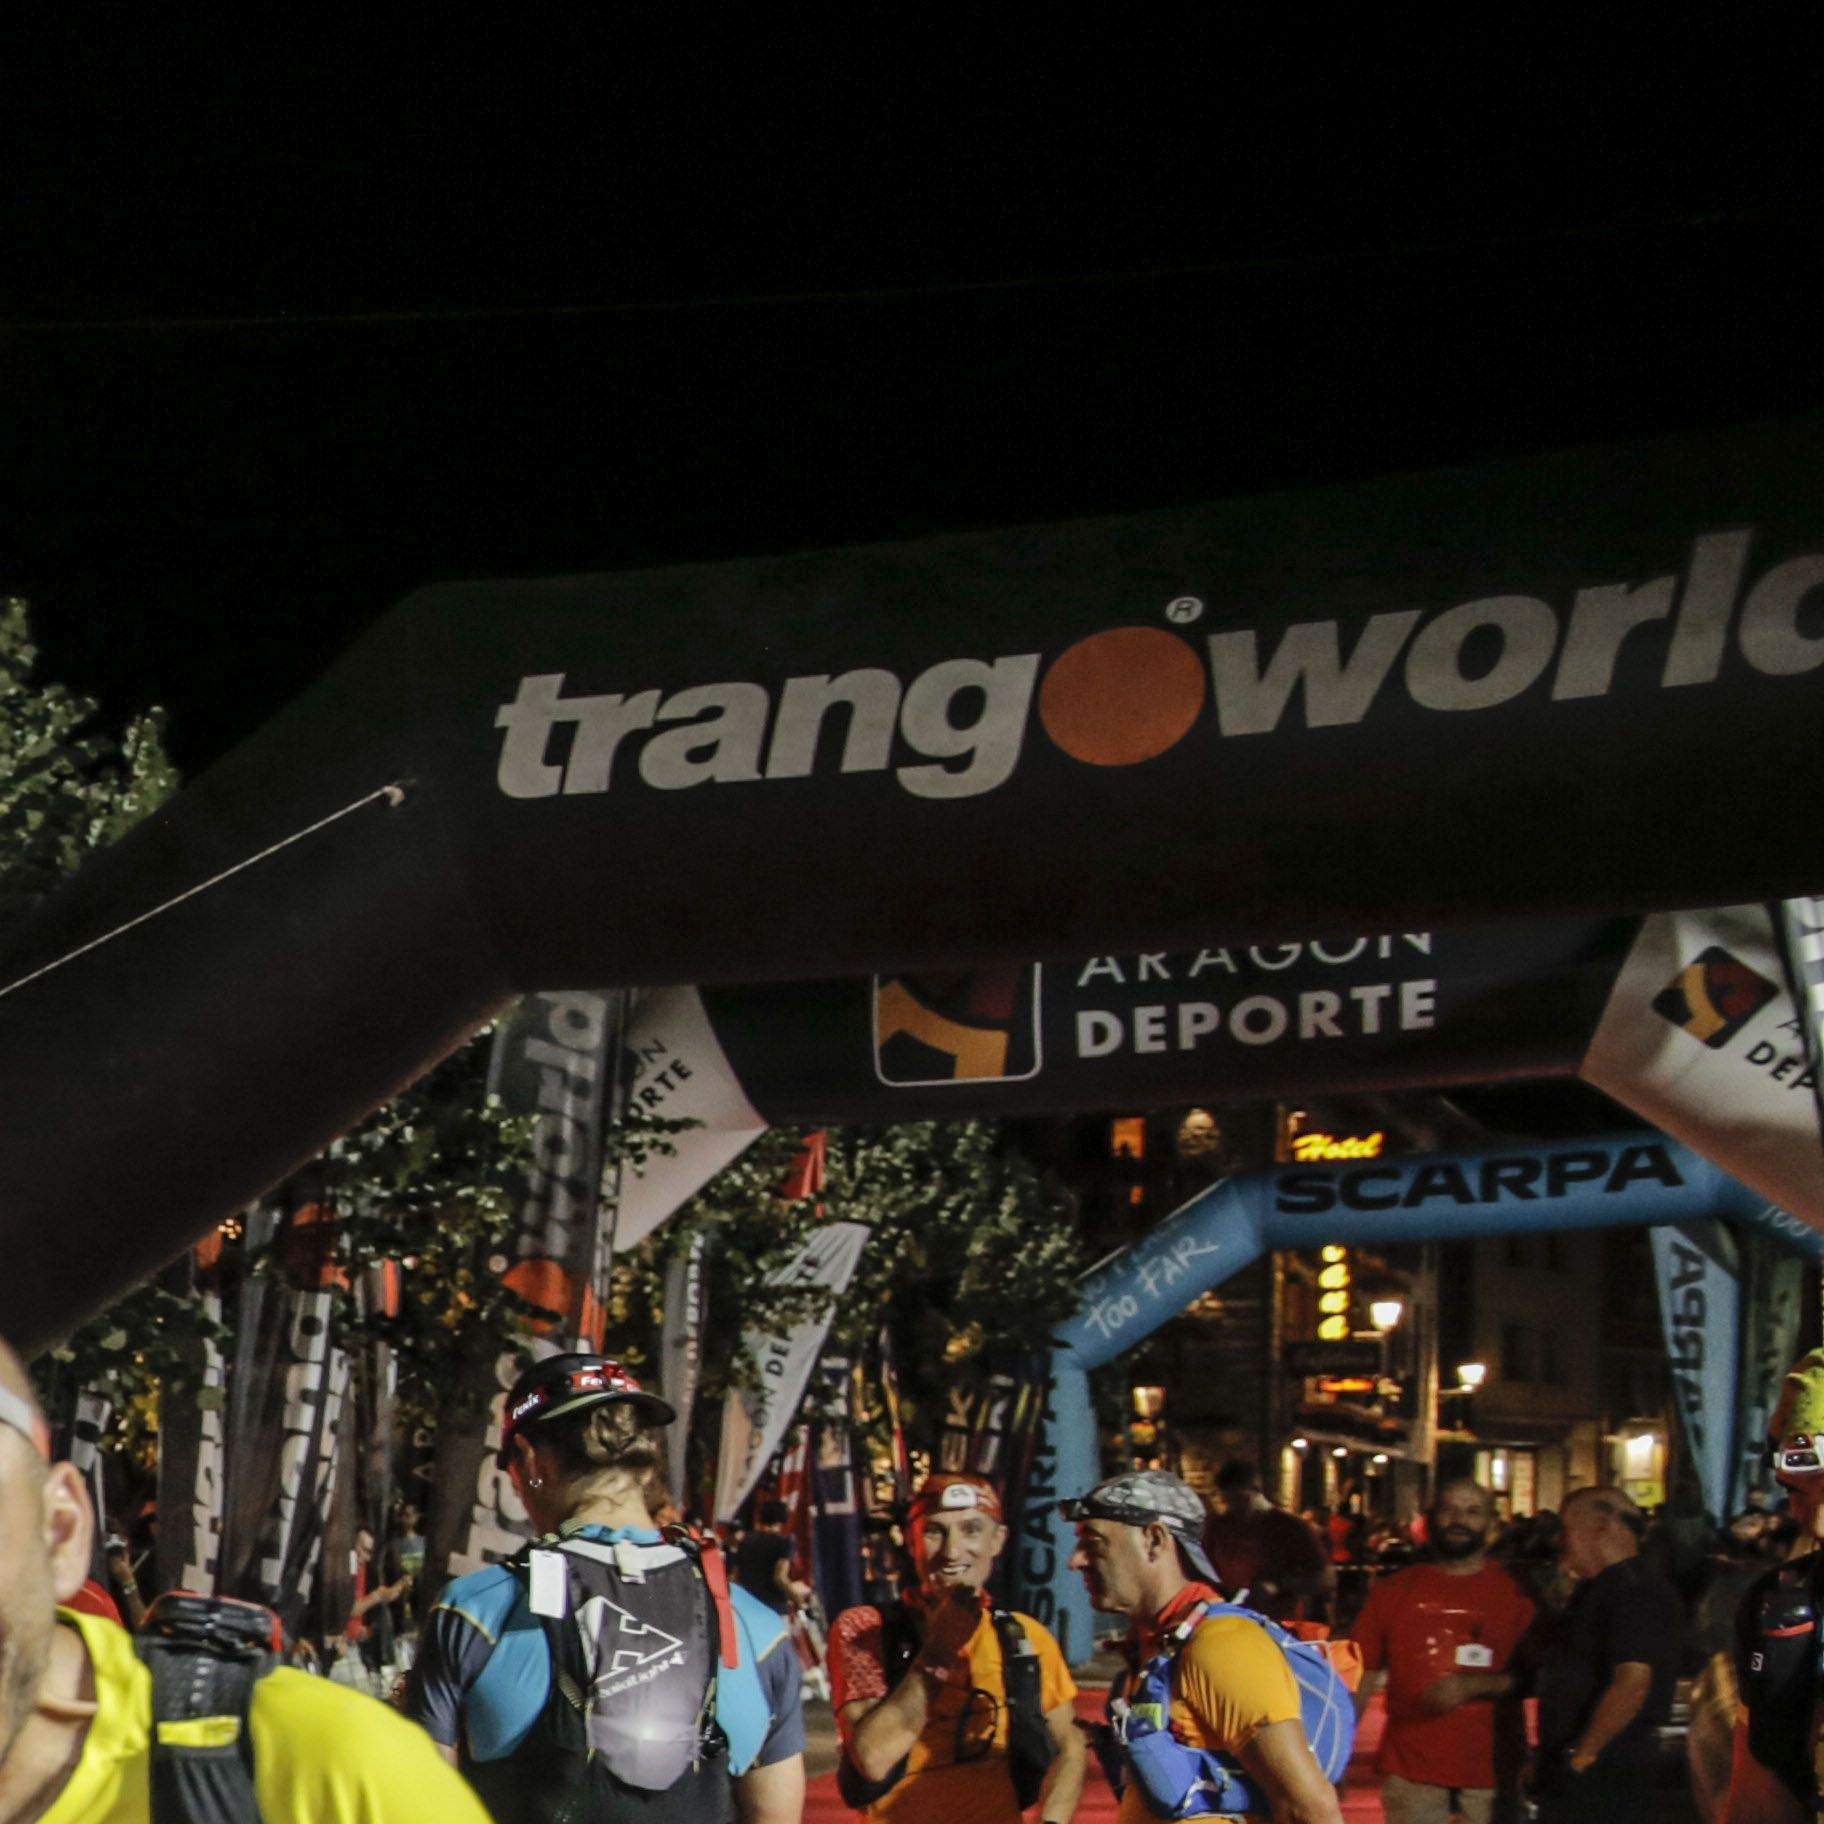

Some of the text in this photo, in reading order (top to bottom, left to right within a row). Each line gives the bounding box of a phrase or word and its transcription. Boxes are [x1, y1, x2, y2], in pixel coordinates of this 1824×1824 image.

[1076, 979, 1437, 1059] DEPORTE
[1275, 1143, 1684, 1214] SCARPA
[1292, 1132, 1383, 1161] Hotel
